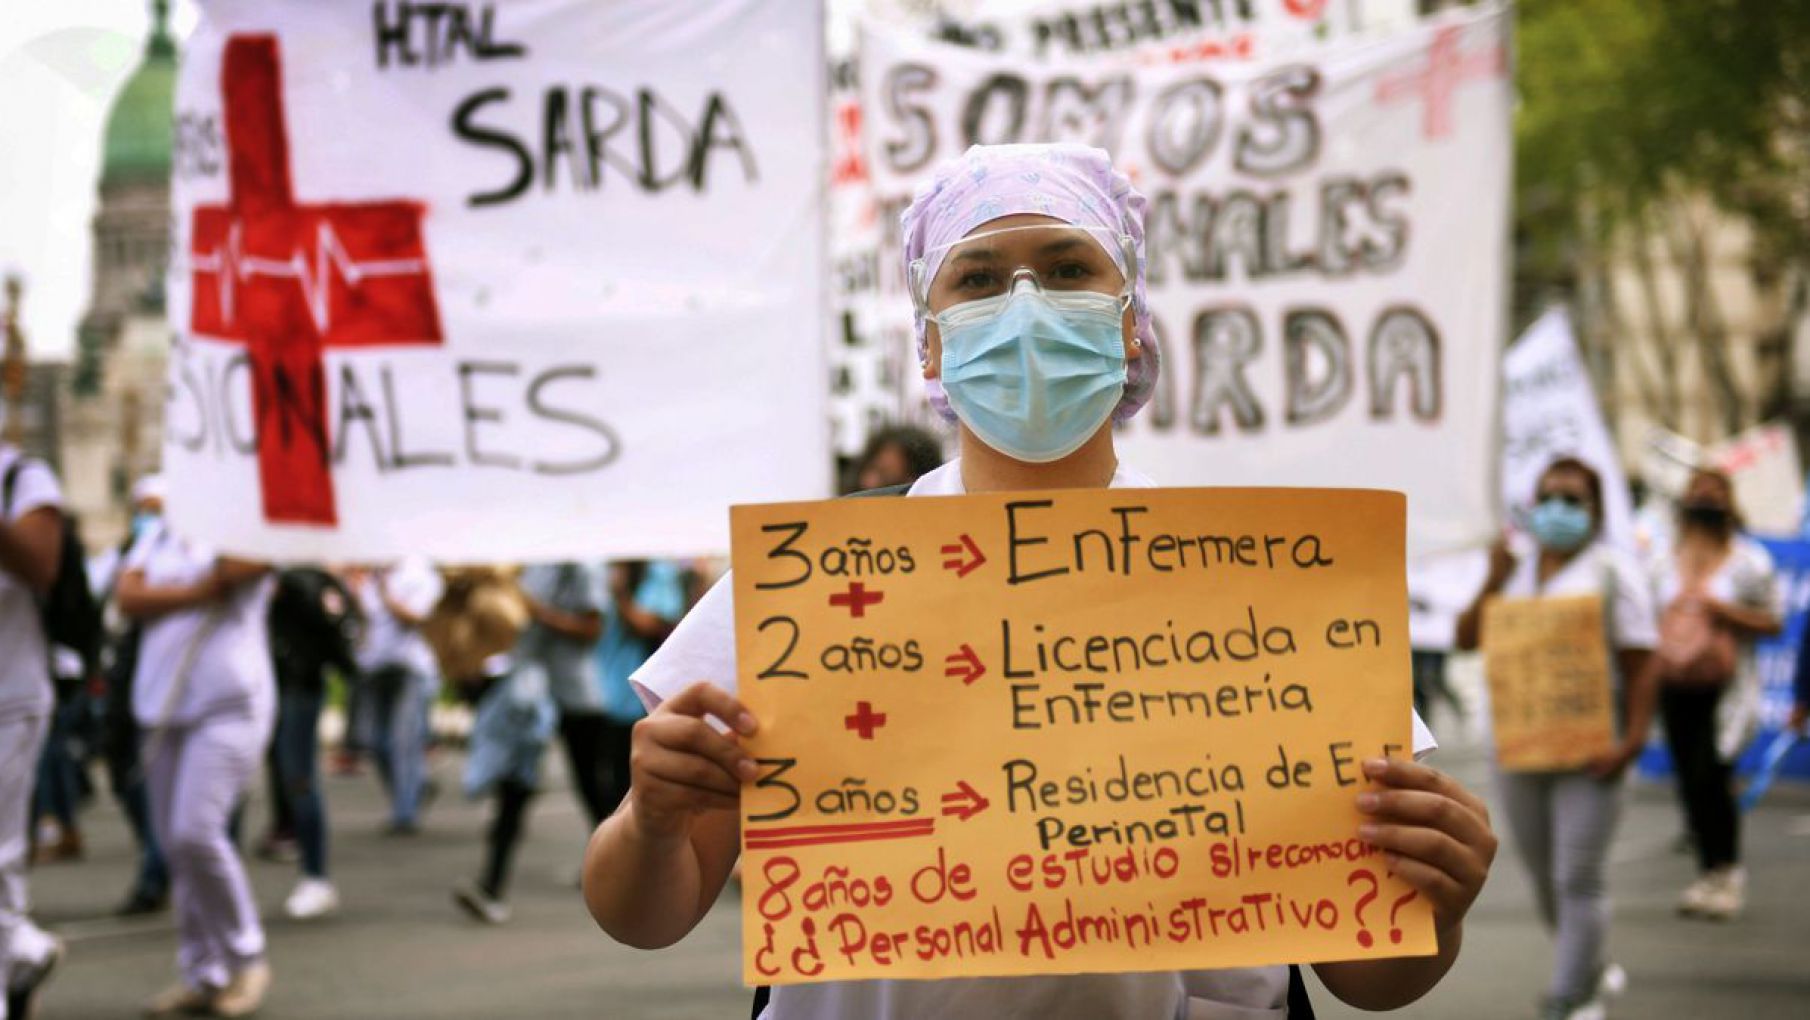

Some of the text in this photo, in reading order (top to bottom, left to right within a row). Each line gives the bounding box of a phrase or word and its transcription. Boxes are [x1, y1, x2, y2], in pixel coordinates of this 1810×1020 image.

[451, 86, 760, 207] SARDA
[882, 64, 1324, 176] SOMOS
[1145, 172, 1412, 286] NALES
[754, 521, 813, 591] 3
[819, 537, 916, 578] años
[756, 605, 1381, 681] 2 años Licenciada en
[747, 757, 802, 823] 3
[814, 776, 920, 816] años
[1001, 755, 1246, 814] Residencia
[1265, 744, 1313, 790] de
[758, 856, 800, 921] 8
[802, 865, 893, 912] años
[910, 846, 977, 904] de
